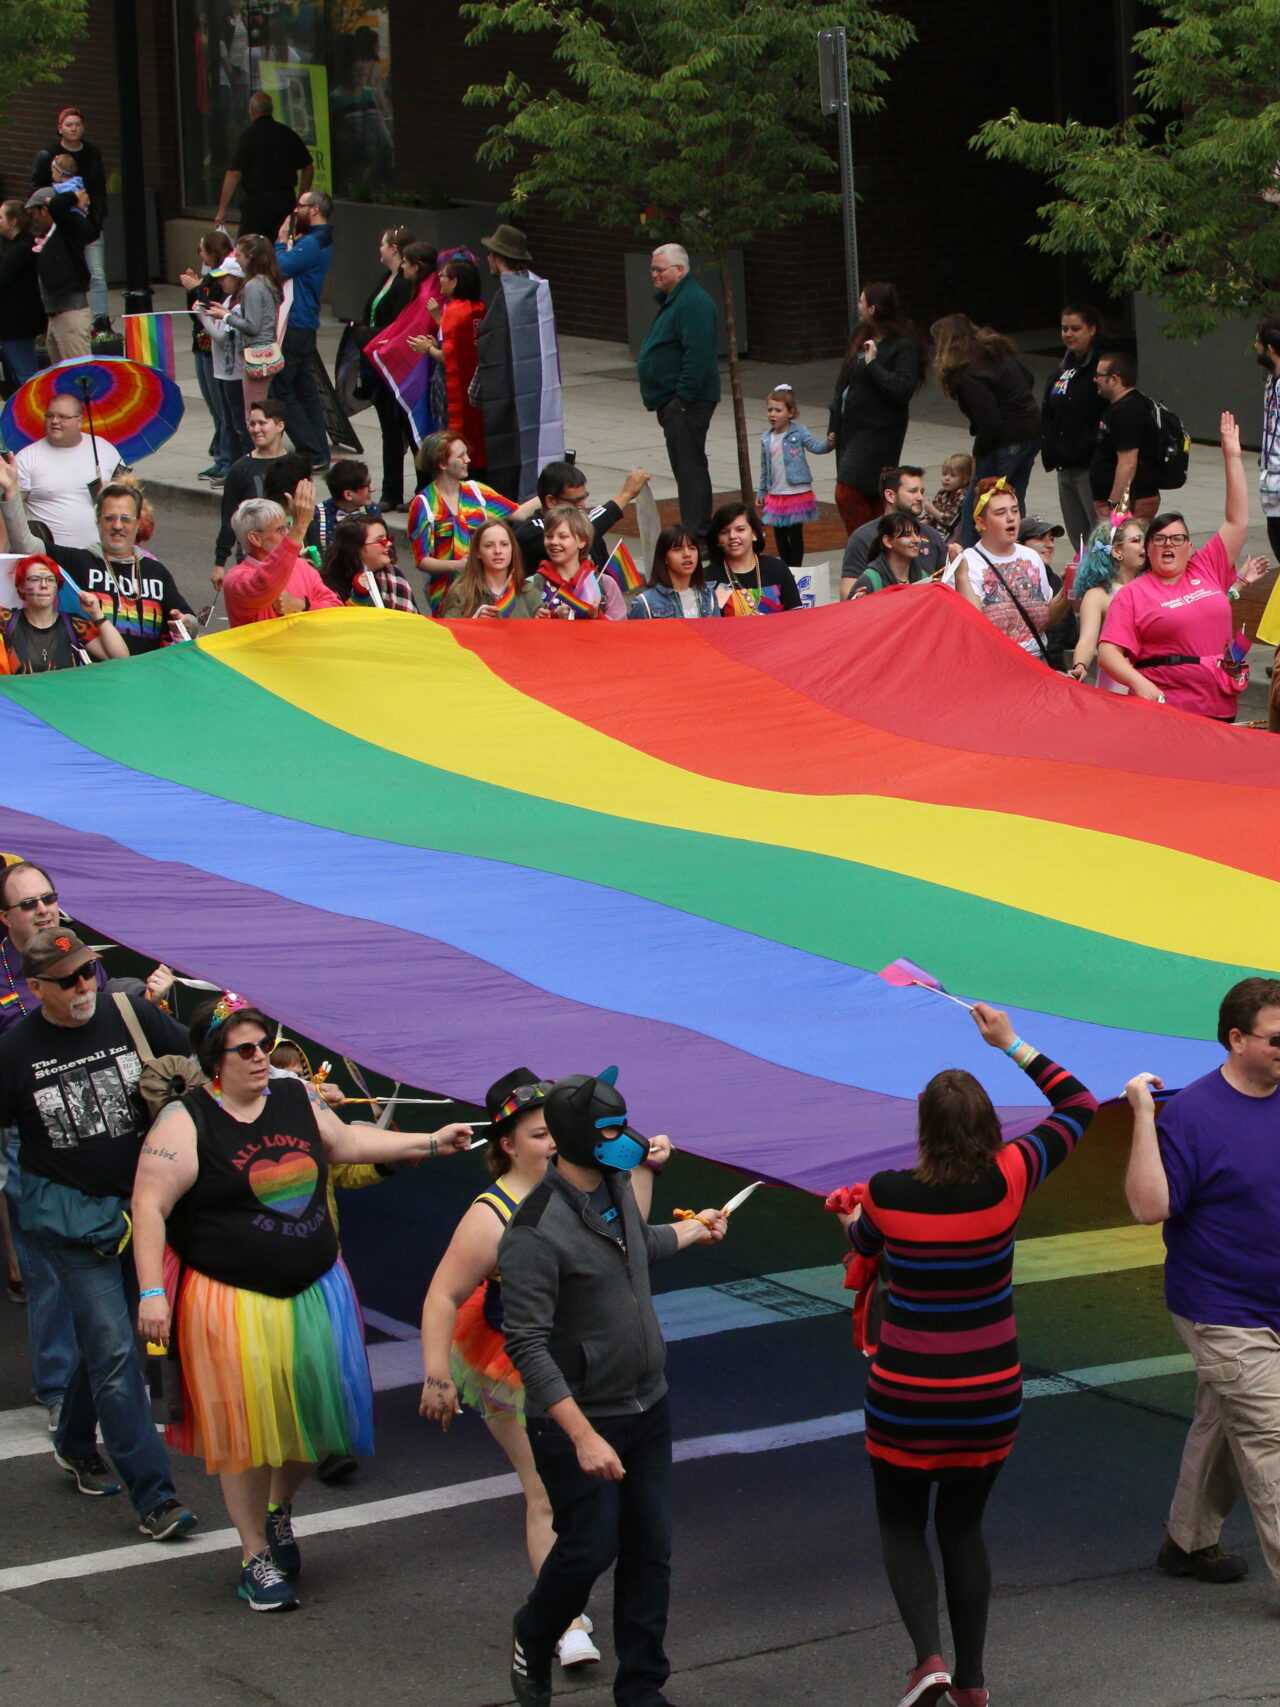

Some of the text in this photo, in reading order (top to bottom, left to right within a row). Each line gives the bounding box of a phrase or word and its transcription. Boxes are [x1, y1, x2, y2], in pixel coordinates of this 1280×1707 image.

[88, 568, 164, 601] PROUD
[32, 1057, 58, 1070] The
[34, 1050, 108, 1079] Stonewall
[231, 1134, 311, 1171] ALL LOVE
[251, 1205, 326, 1239] IS EQUAL
